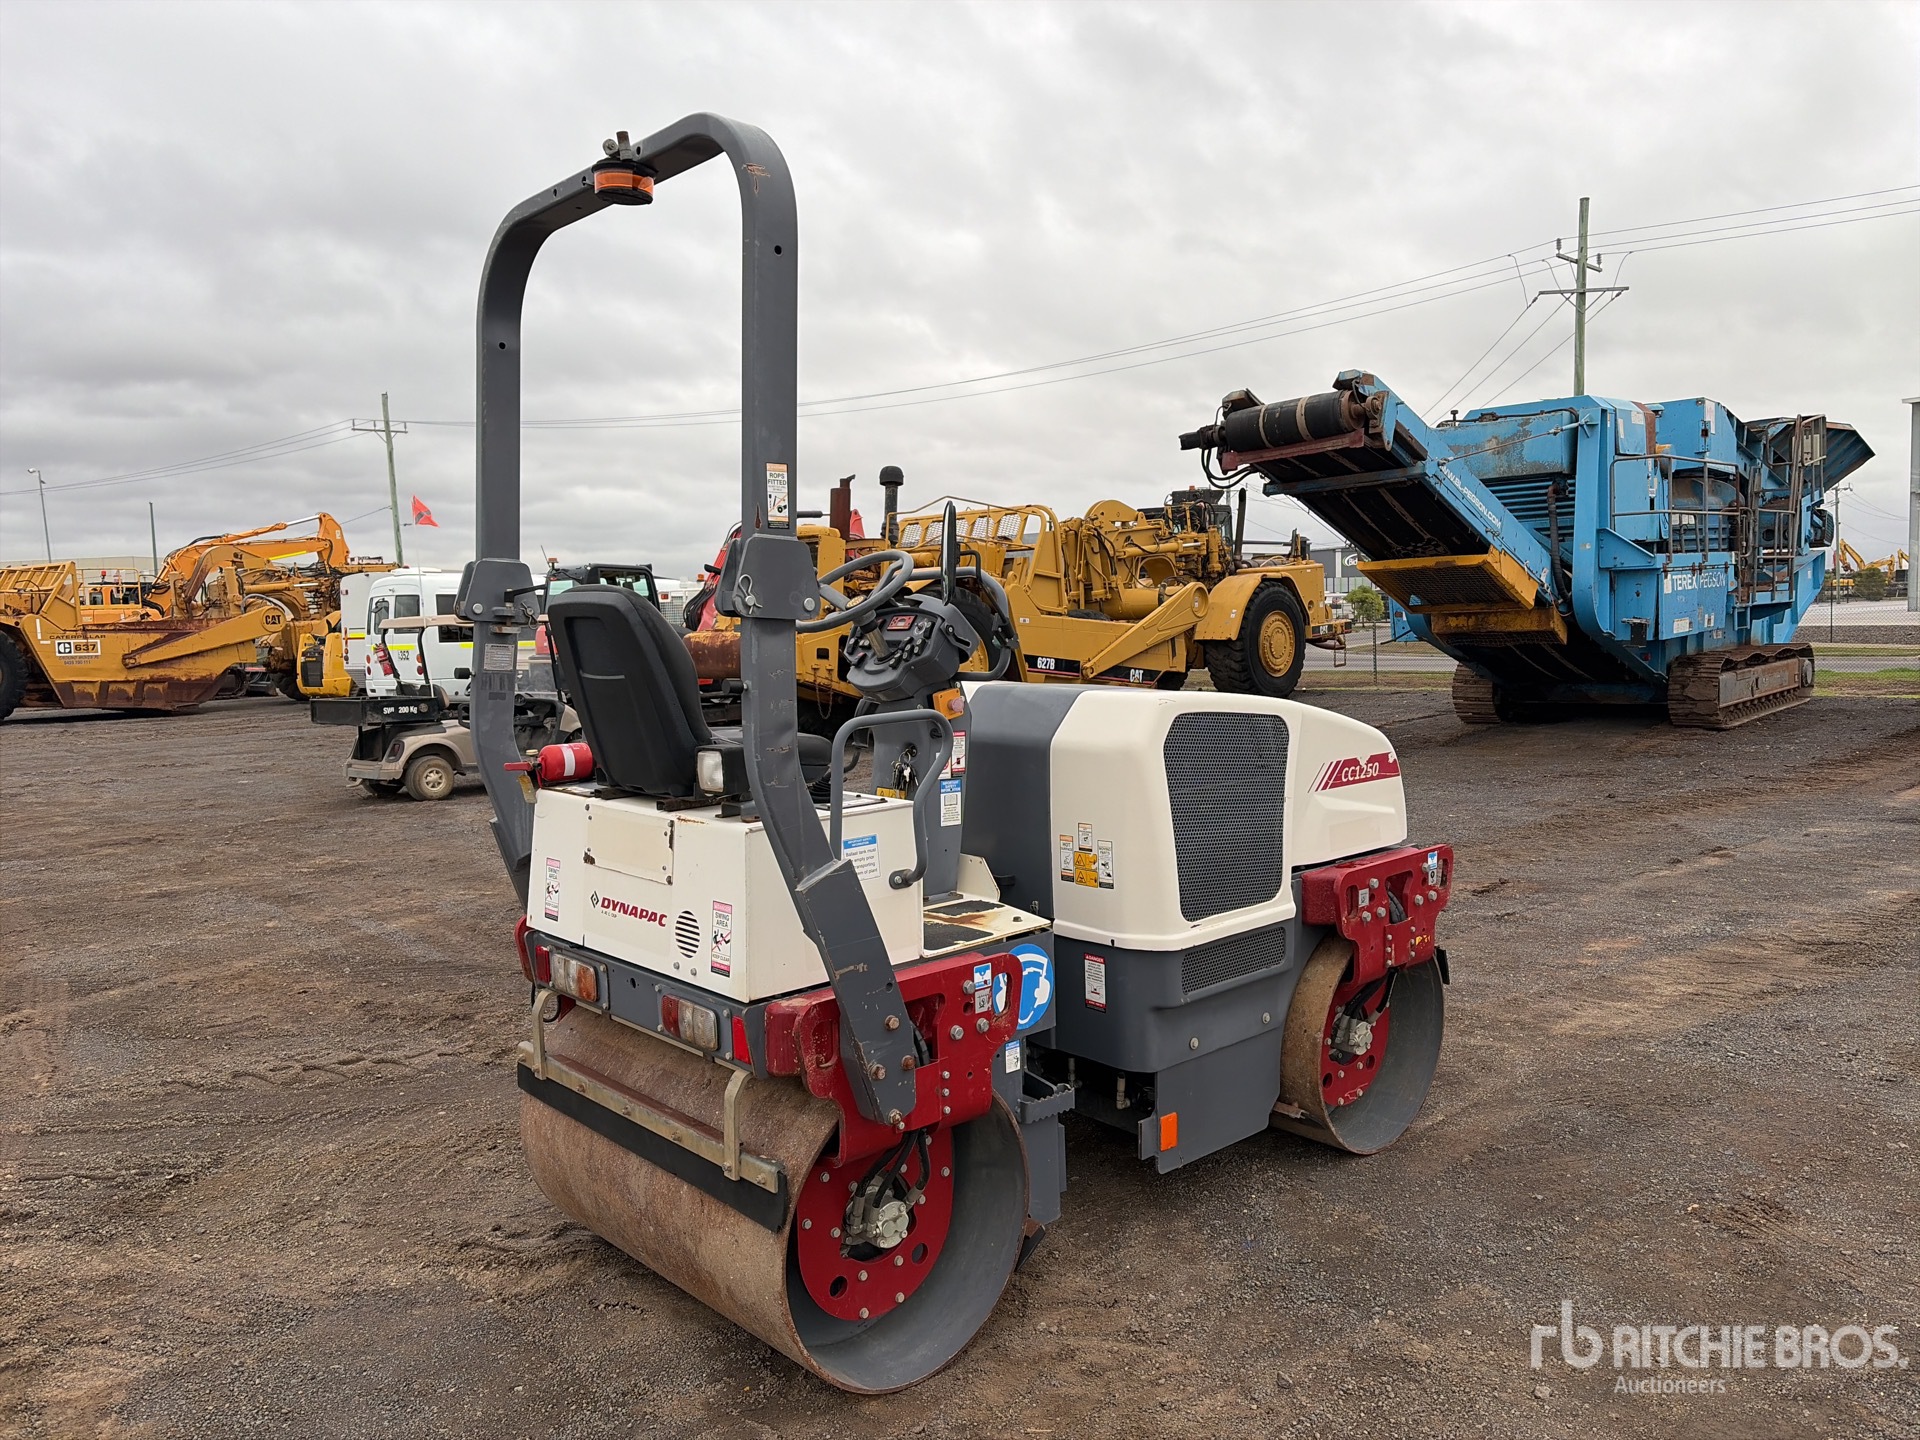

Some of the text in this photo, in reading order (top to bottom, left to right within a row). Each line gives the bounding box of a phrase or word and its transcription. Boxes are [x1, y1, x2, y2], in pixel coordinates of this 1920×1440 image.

[1673, 572, 1726, 591] TEREX PEGSON
[265, 614, 282, 625] CAT
[74, 643, 96, 652] 637
[1037, 657, 1055, 670] 627B
[1129, 668, 1144, 683] CAT
[1341, 762, 1379, 782] CC1250
[601, 896, 668, 927] DYNAPAC
[715, 911, 729, 921] SWING
[716, 919, 729, 928] AREA
